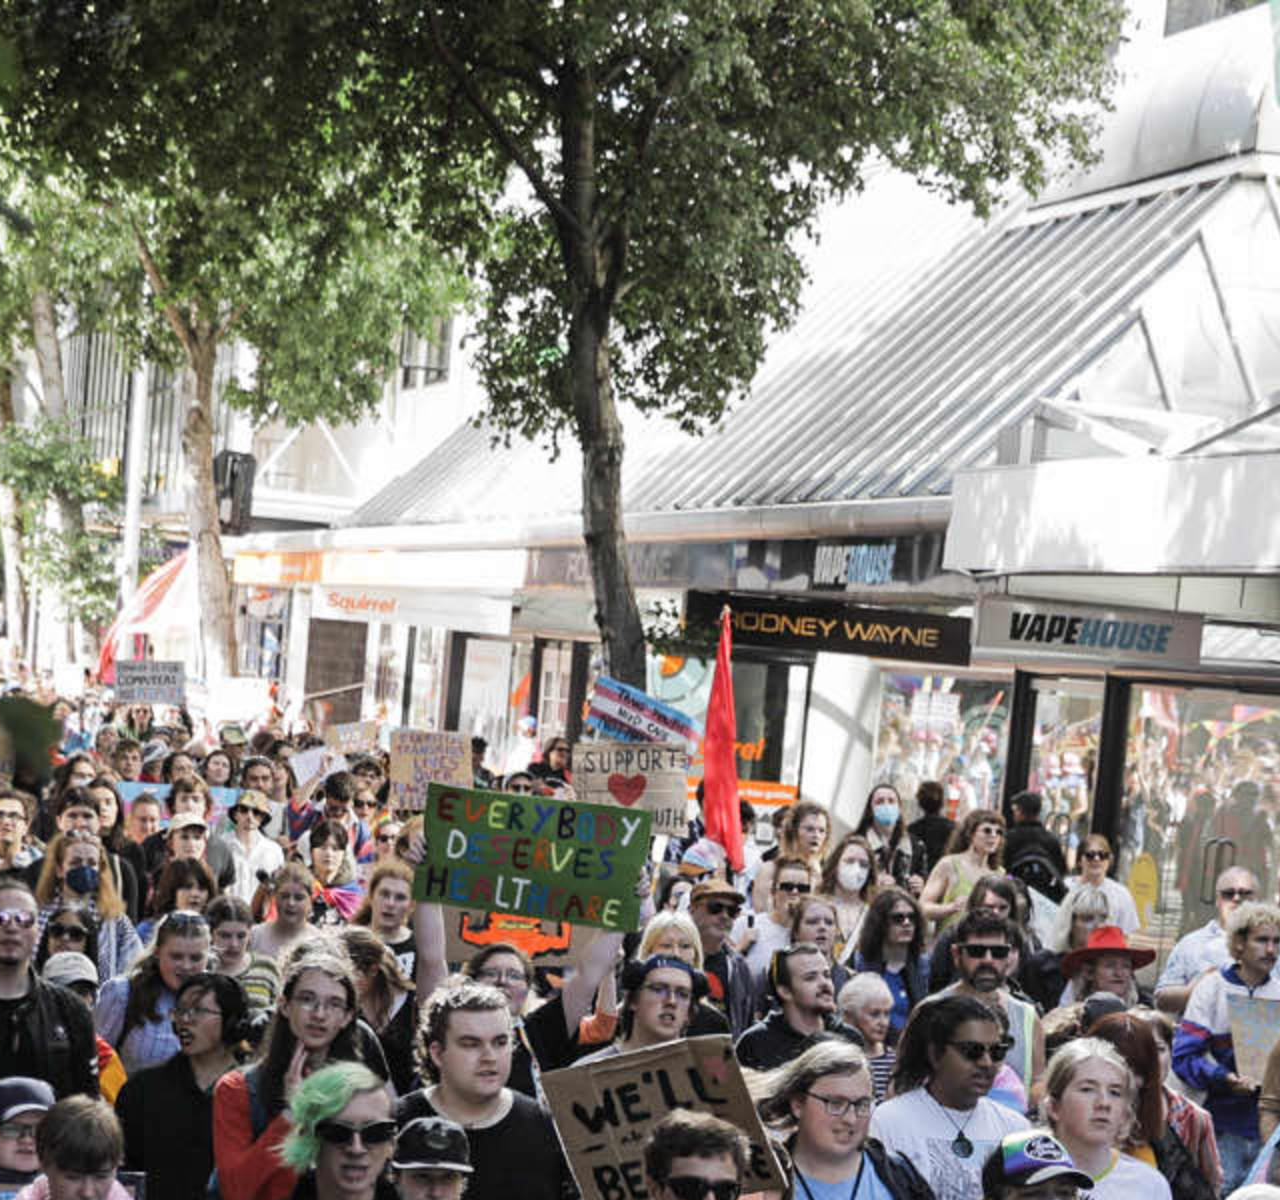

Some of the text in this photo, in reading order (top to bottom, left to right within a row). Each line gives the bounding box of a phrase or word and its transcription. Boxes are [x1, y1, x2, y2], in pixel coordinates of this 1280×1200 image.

[813, 544, 896, 585] VAPEHOUSE
[326, 591, 396, 613] Squirrel
[844, 622, 940, 648] WAYNE
[1008, 611, 1173, 654] VAPEHOUSE
[584, 748, 679, 774] SUPPORT
[436, 791, 641, 847] EVERYBODY
[655, 807, 685, 826] UTH
[447, 828, 616, 880] DESERVES
[426, 865, 622, 927] HEALTHCARE
[572, 1067, 728, 1134] WE'LL
